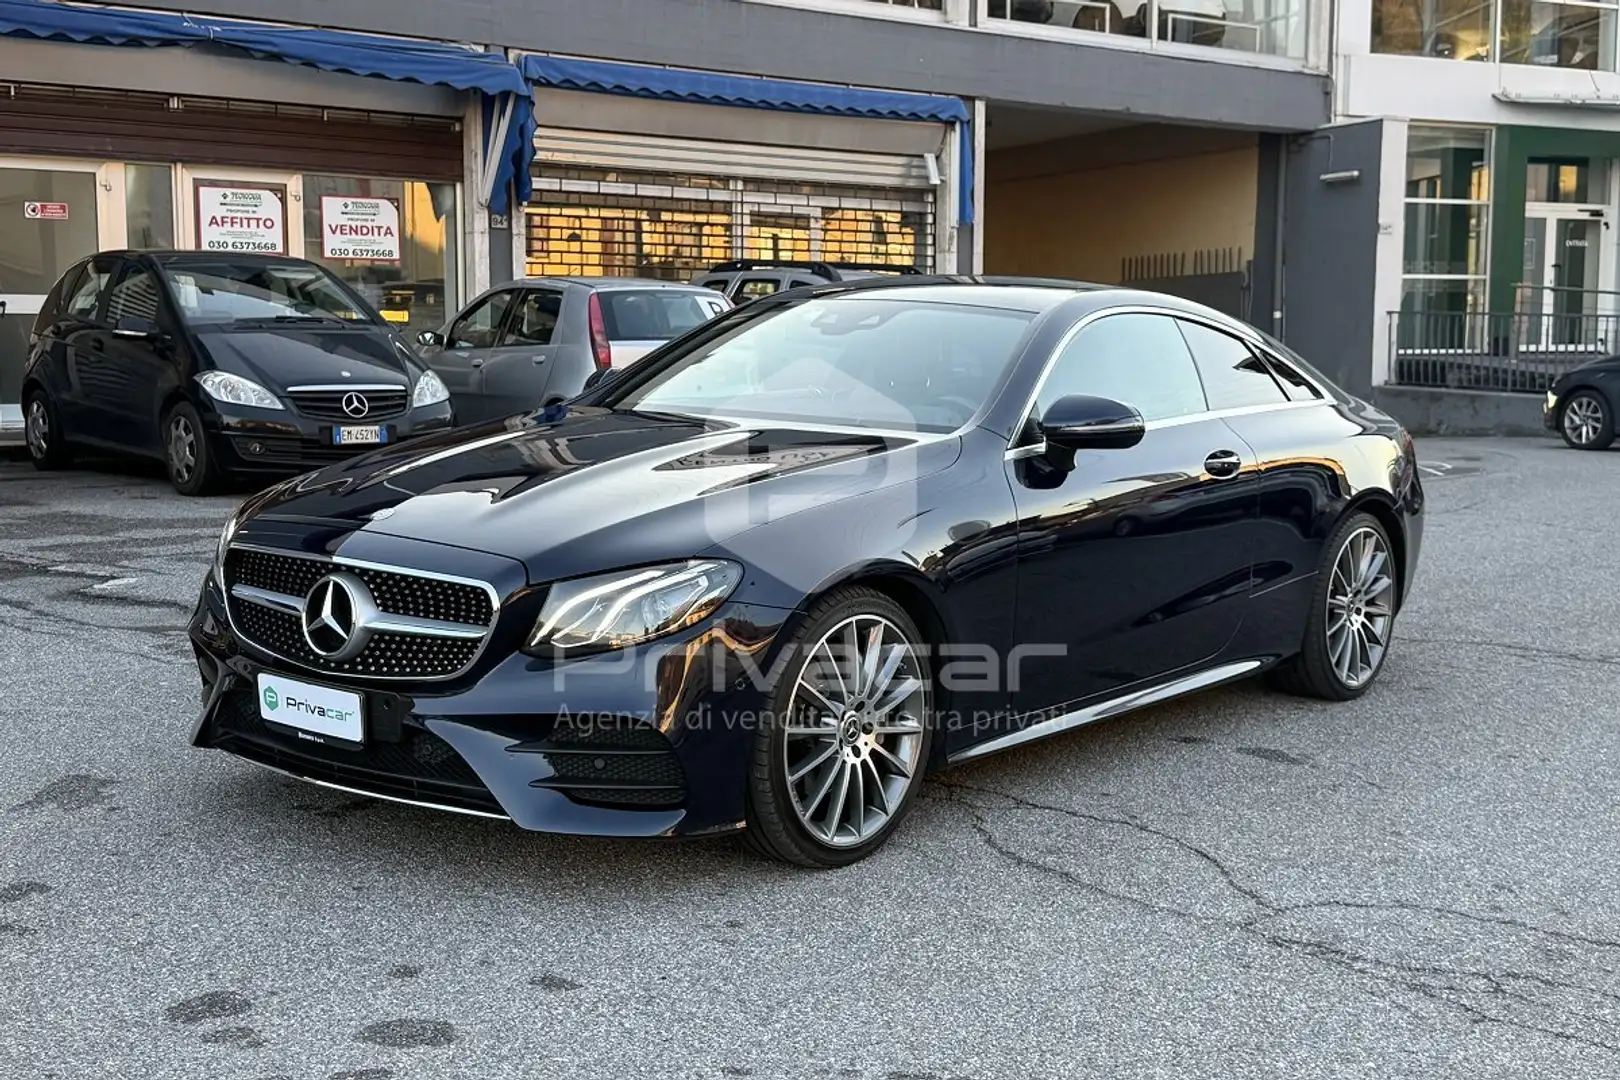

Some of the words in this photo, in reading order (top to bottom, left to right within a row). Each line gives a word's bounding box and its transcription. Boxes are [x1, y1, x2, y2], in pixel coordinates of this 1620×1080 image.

[208, 215, 275, 229] AFFITTO
[328, 224, 394, 237] VENDITA
[208, 240, 229, 249] 030
[231, 241, 277, 250] 6373668
[330, 248, 350, 256] 030
[352, 248, 394, 257] 6373668
[286, 696, 353, 722] Privacar
